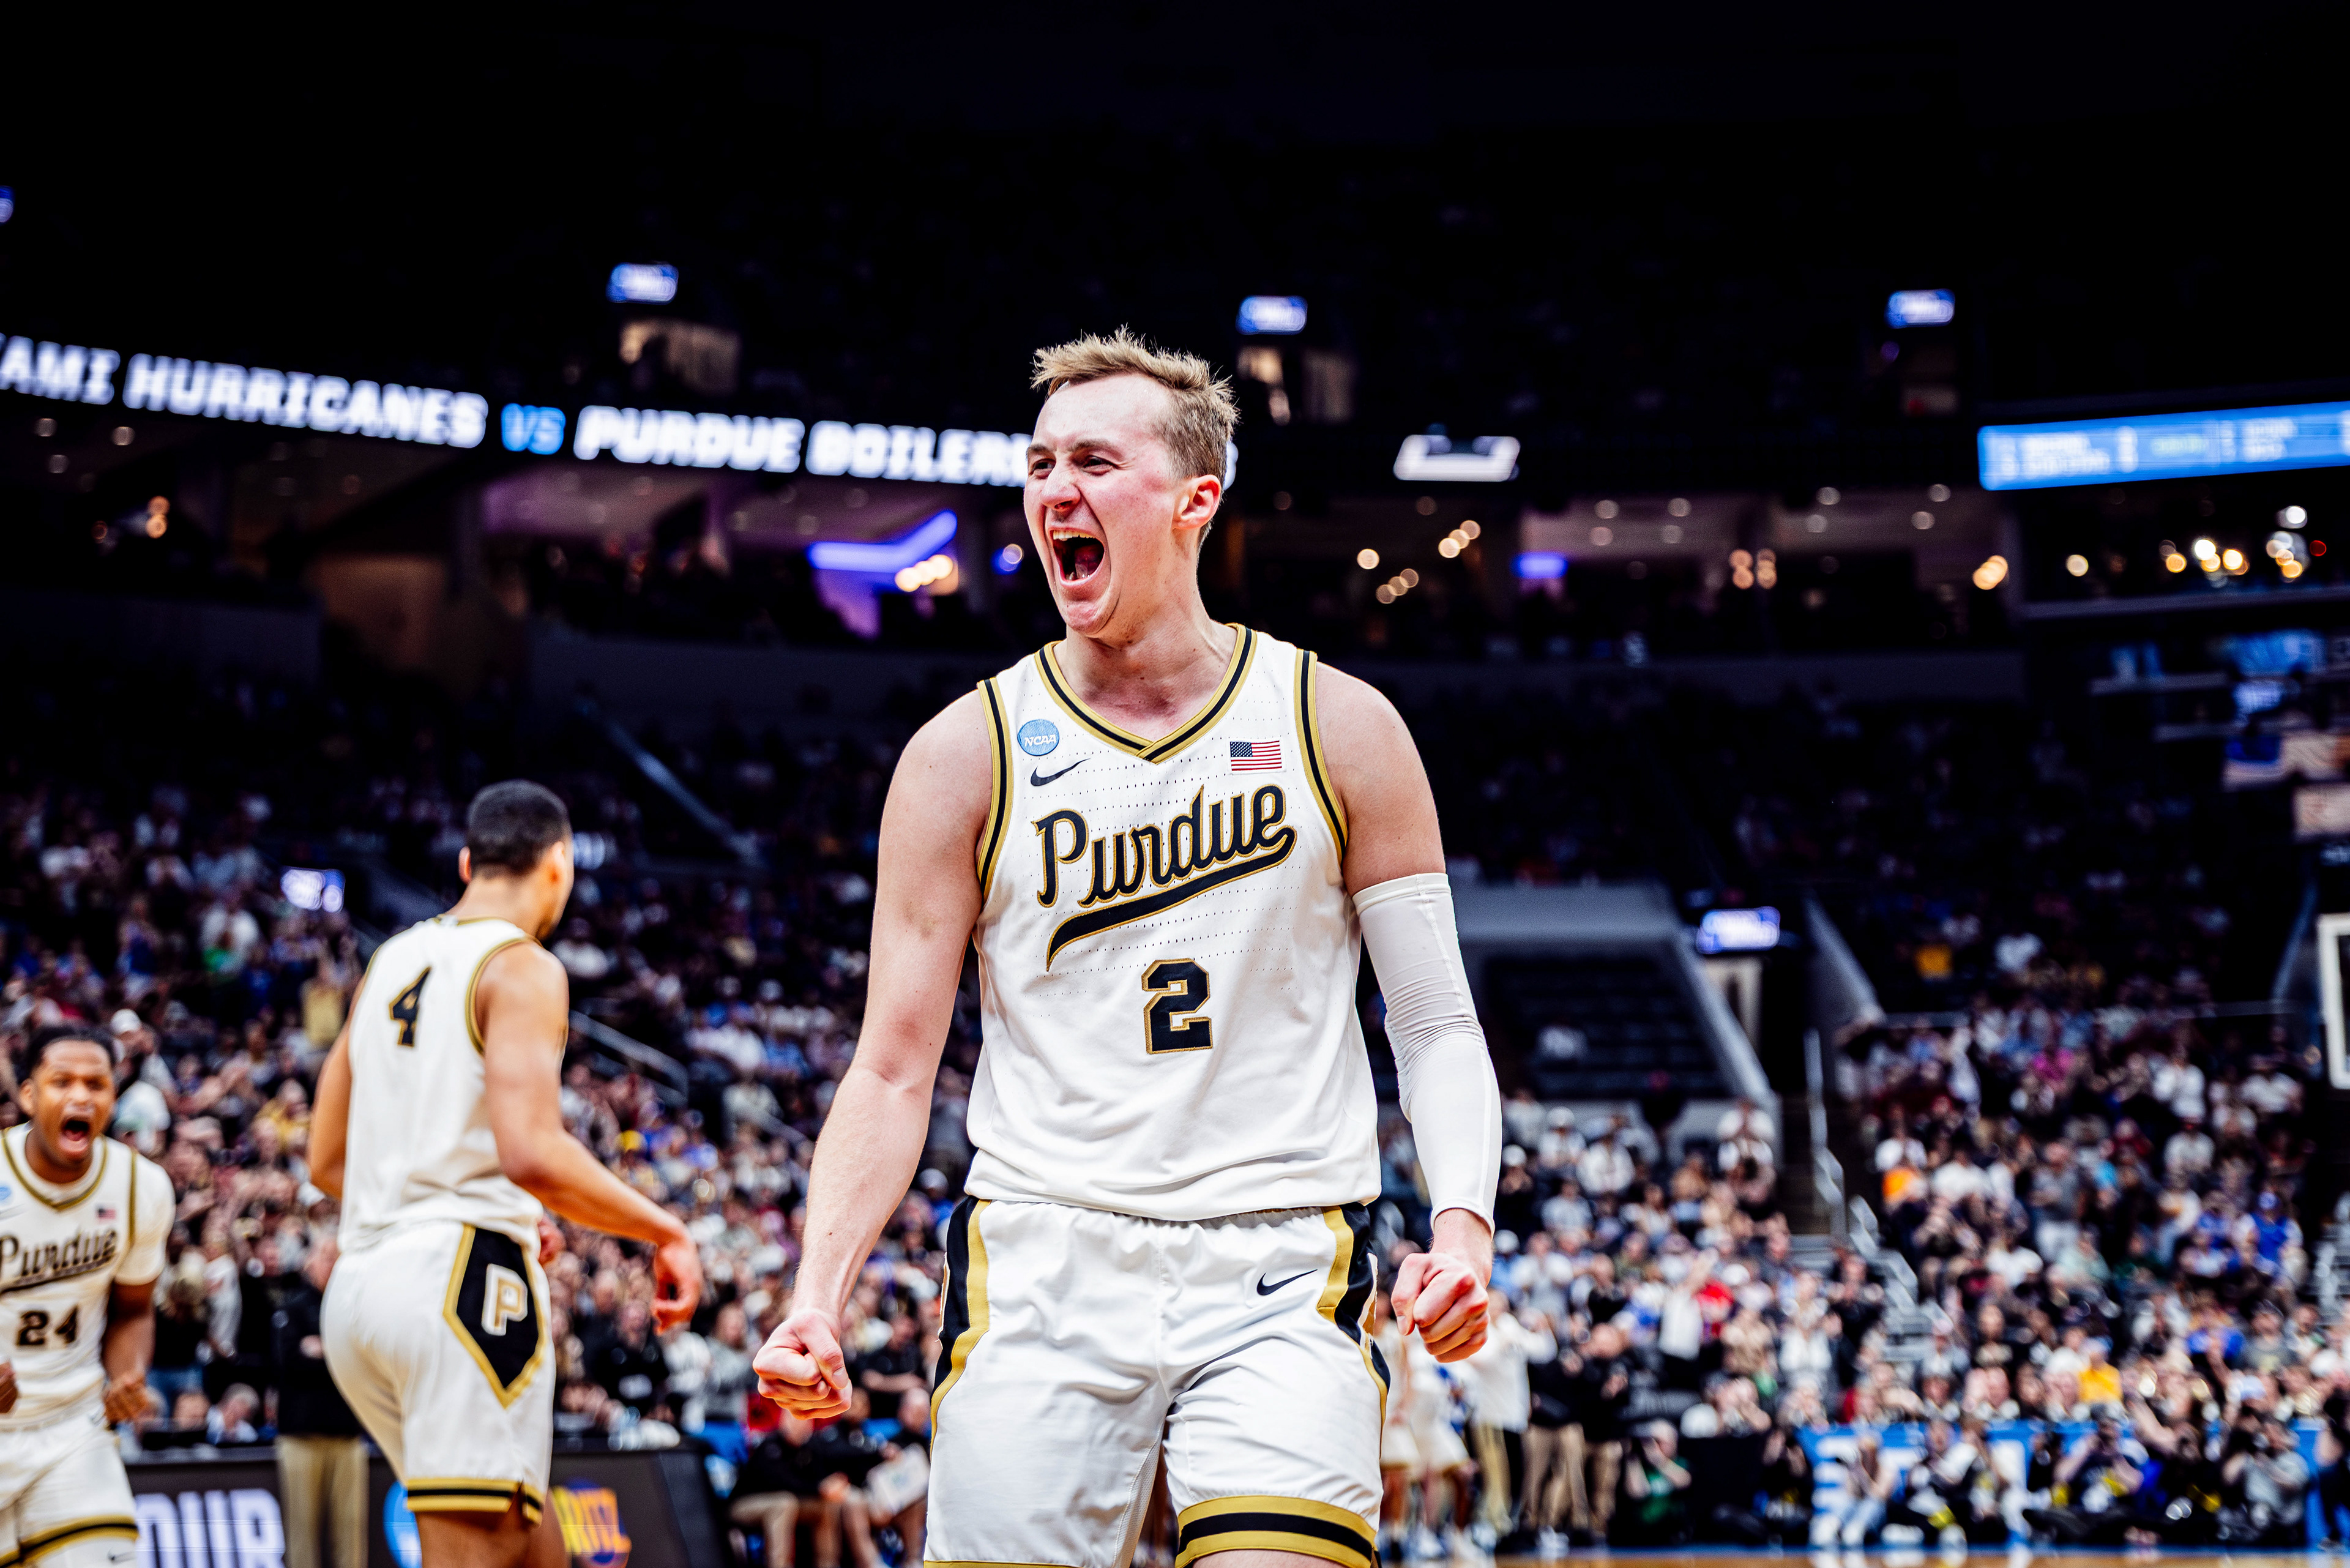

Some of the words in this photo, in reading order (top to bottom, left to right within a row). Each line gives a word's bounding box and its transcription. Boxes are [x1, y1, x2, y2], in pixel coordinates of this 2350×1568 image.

[0, 332, 121, 405] AMI
[122, 353, 488, 449] HURRICANES
[501, 403, 566, 455] VS
[573, 405, 805, 472] PURDUE
[1024, 734, 1057, 747] NCAA
[1031, 784, 1288, 908] Purdue
[389, 966, 432, 1047] 4
[1141, 957, 1214, 1055] 2
[17, 1307, 80, 1346] 24
[481, 1263, 528, 1335] P
